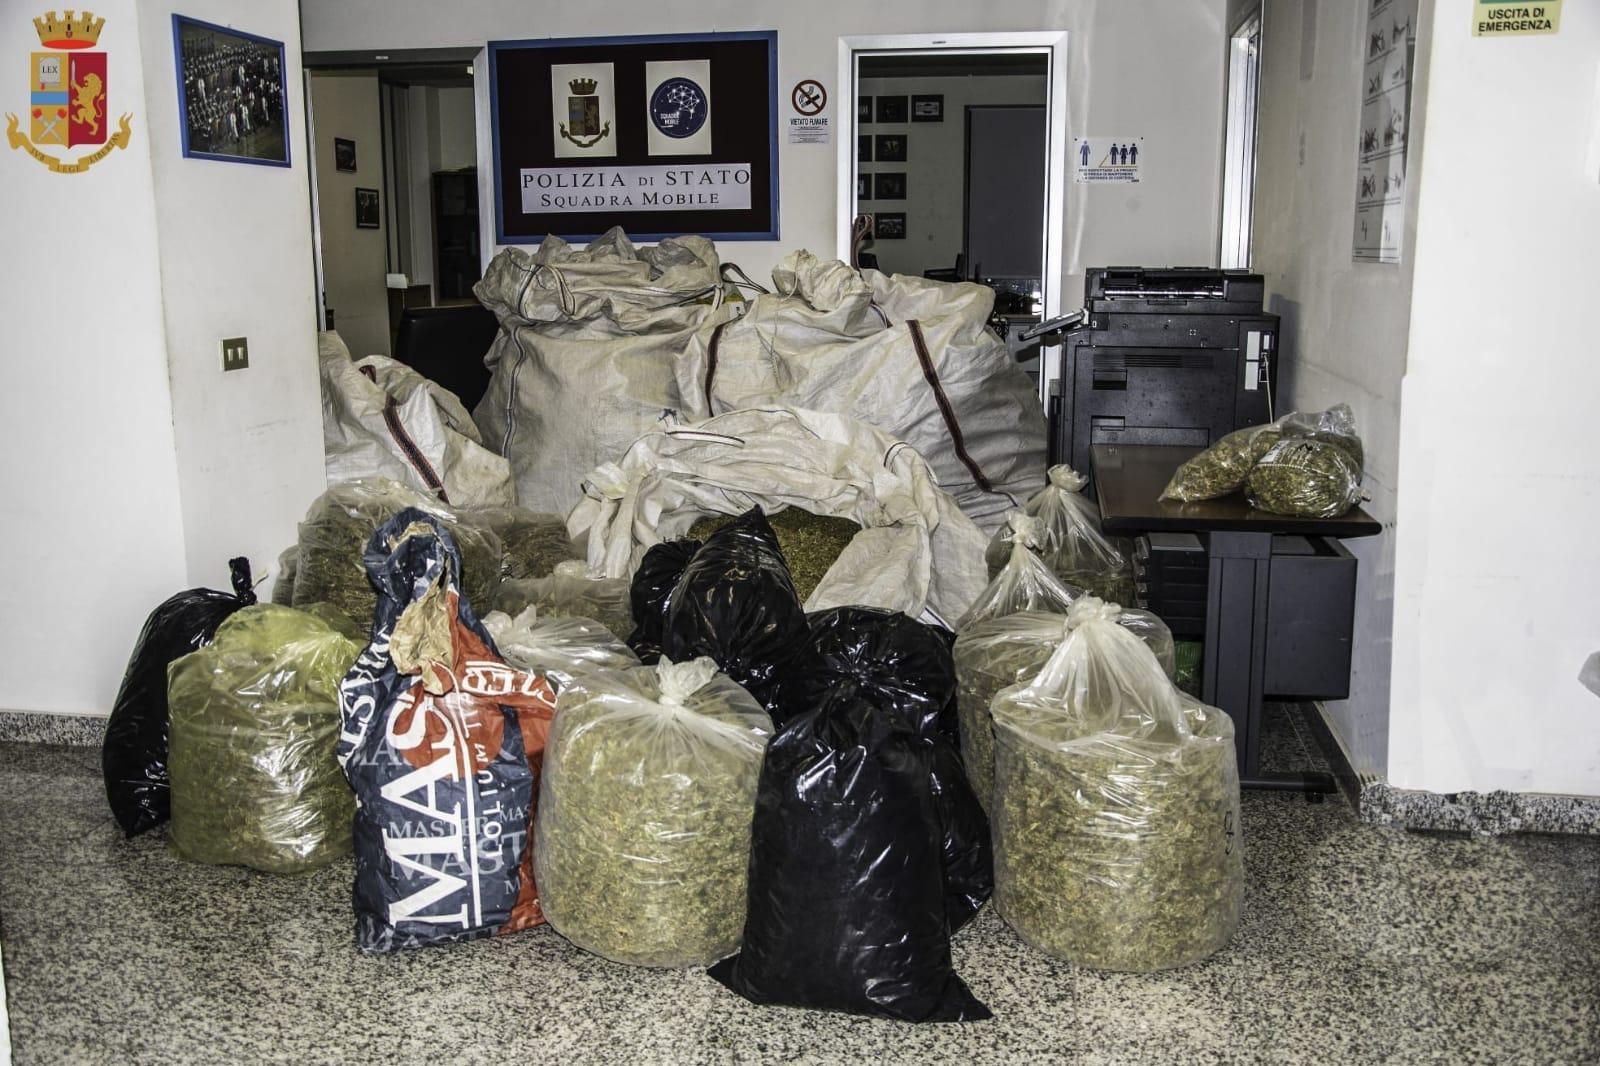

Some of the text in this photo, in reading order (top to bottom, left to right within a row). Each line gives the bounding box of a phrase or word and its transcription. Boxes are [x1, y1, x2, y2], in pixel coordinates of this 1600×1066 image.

[1488, 7, 1545, 19] USCITA DI
[1478, 20, 1552, 32] EMERGENZA
[522, 172, 626, 188] POLIZIA
[665, 169, 750, 186] STATO
[474, 742, 505, 858] LOLIUM
